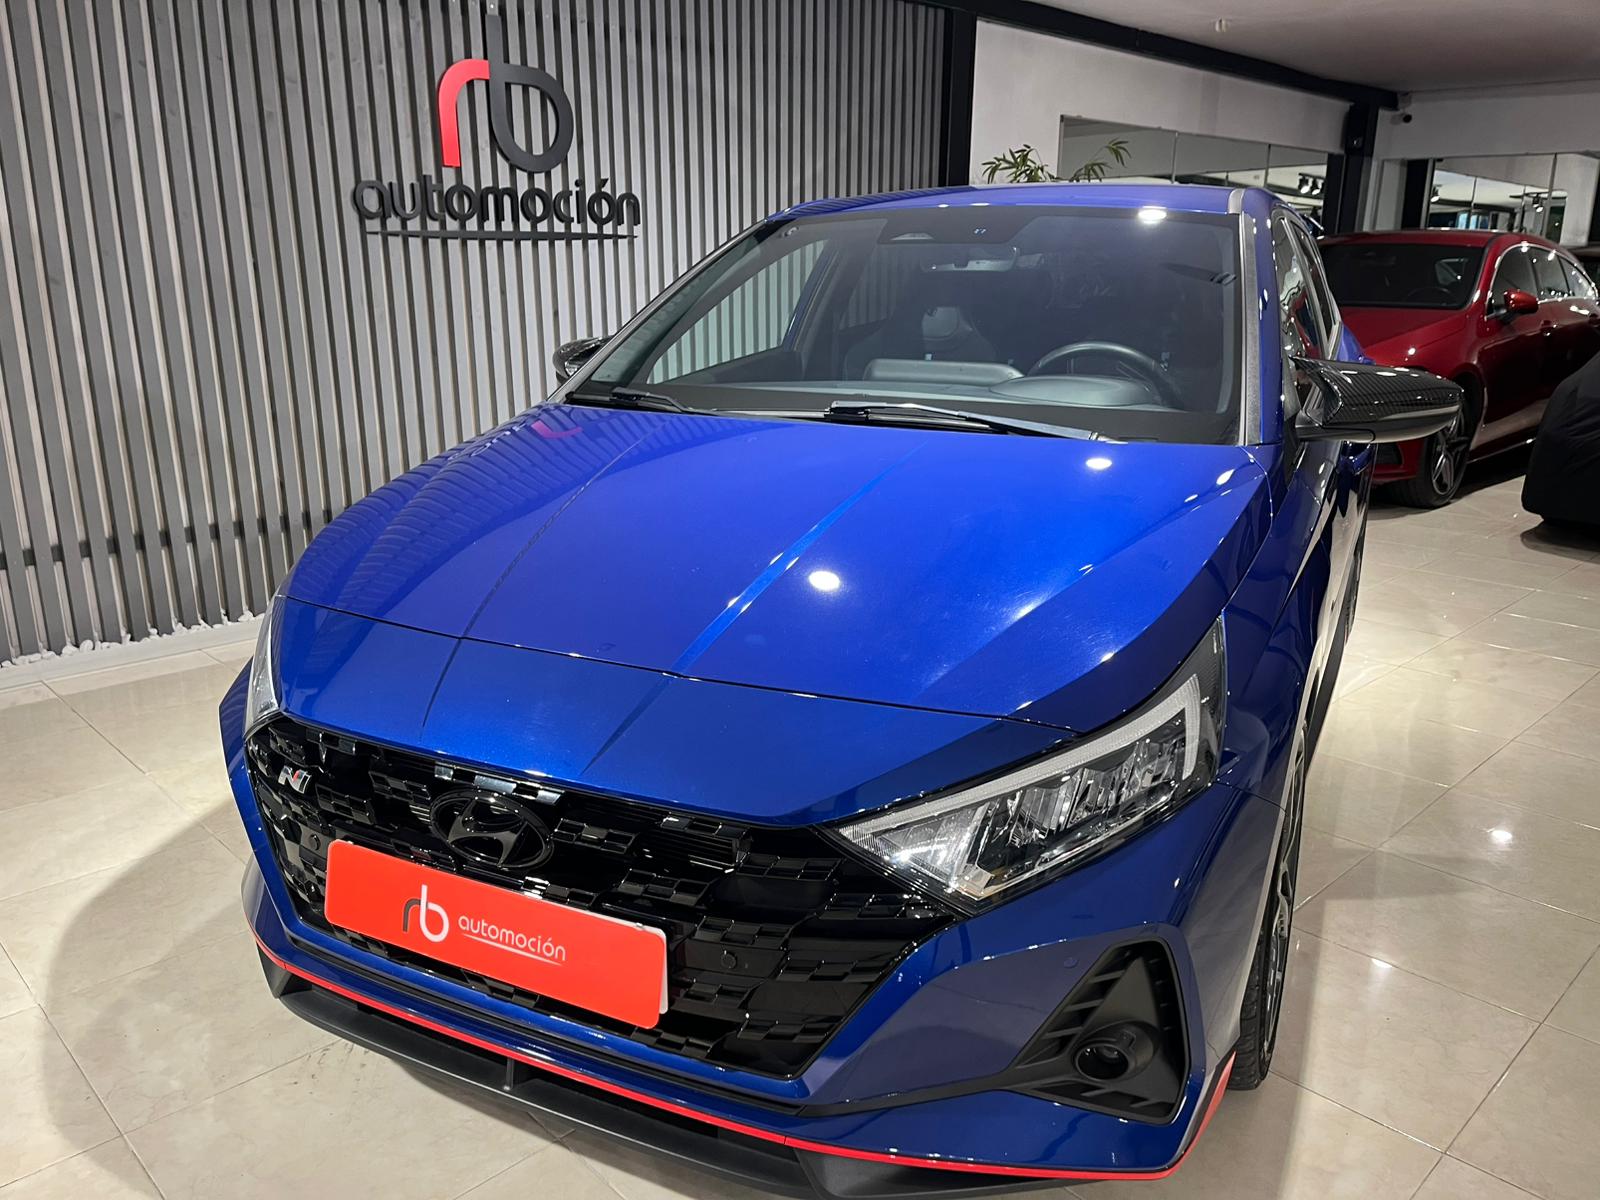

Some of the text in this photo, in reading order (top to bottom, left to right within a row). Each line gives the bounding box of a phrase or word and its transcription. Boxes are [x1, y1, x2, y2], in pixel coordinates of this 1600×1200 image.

[437, 14, 574, 174] rb
[353, 174, 641, 226] automoción
[402, 884, 566, 961] rb automoción
